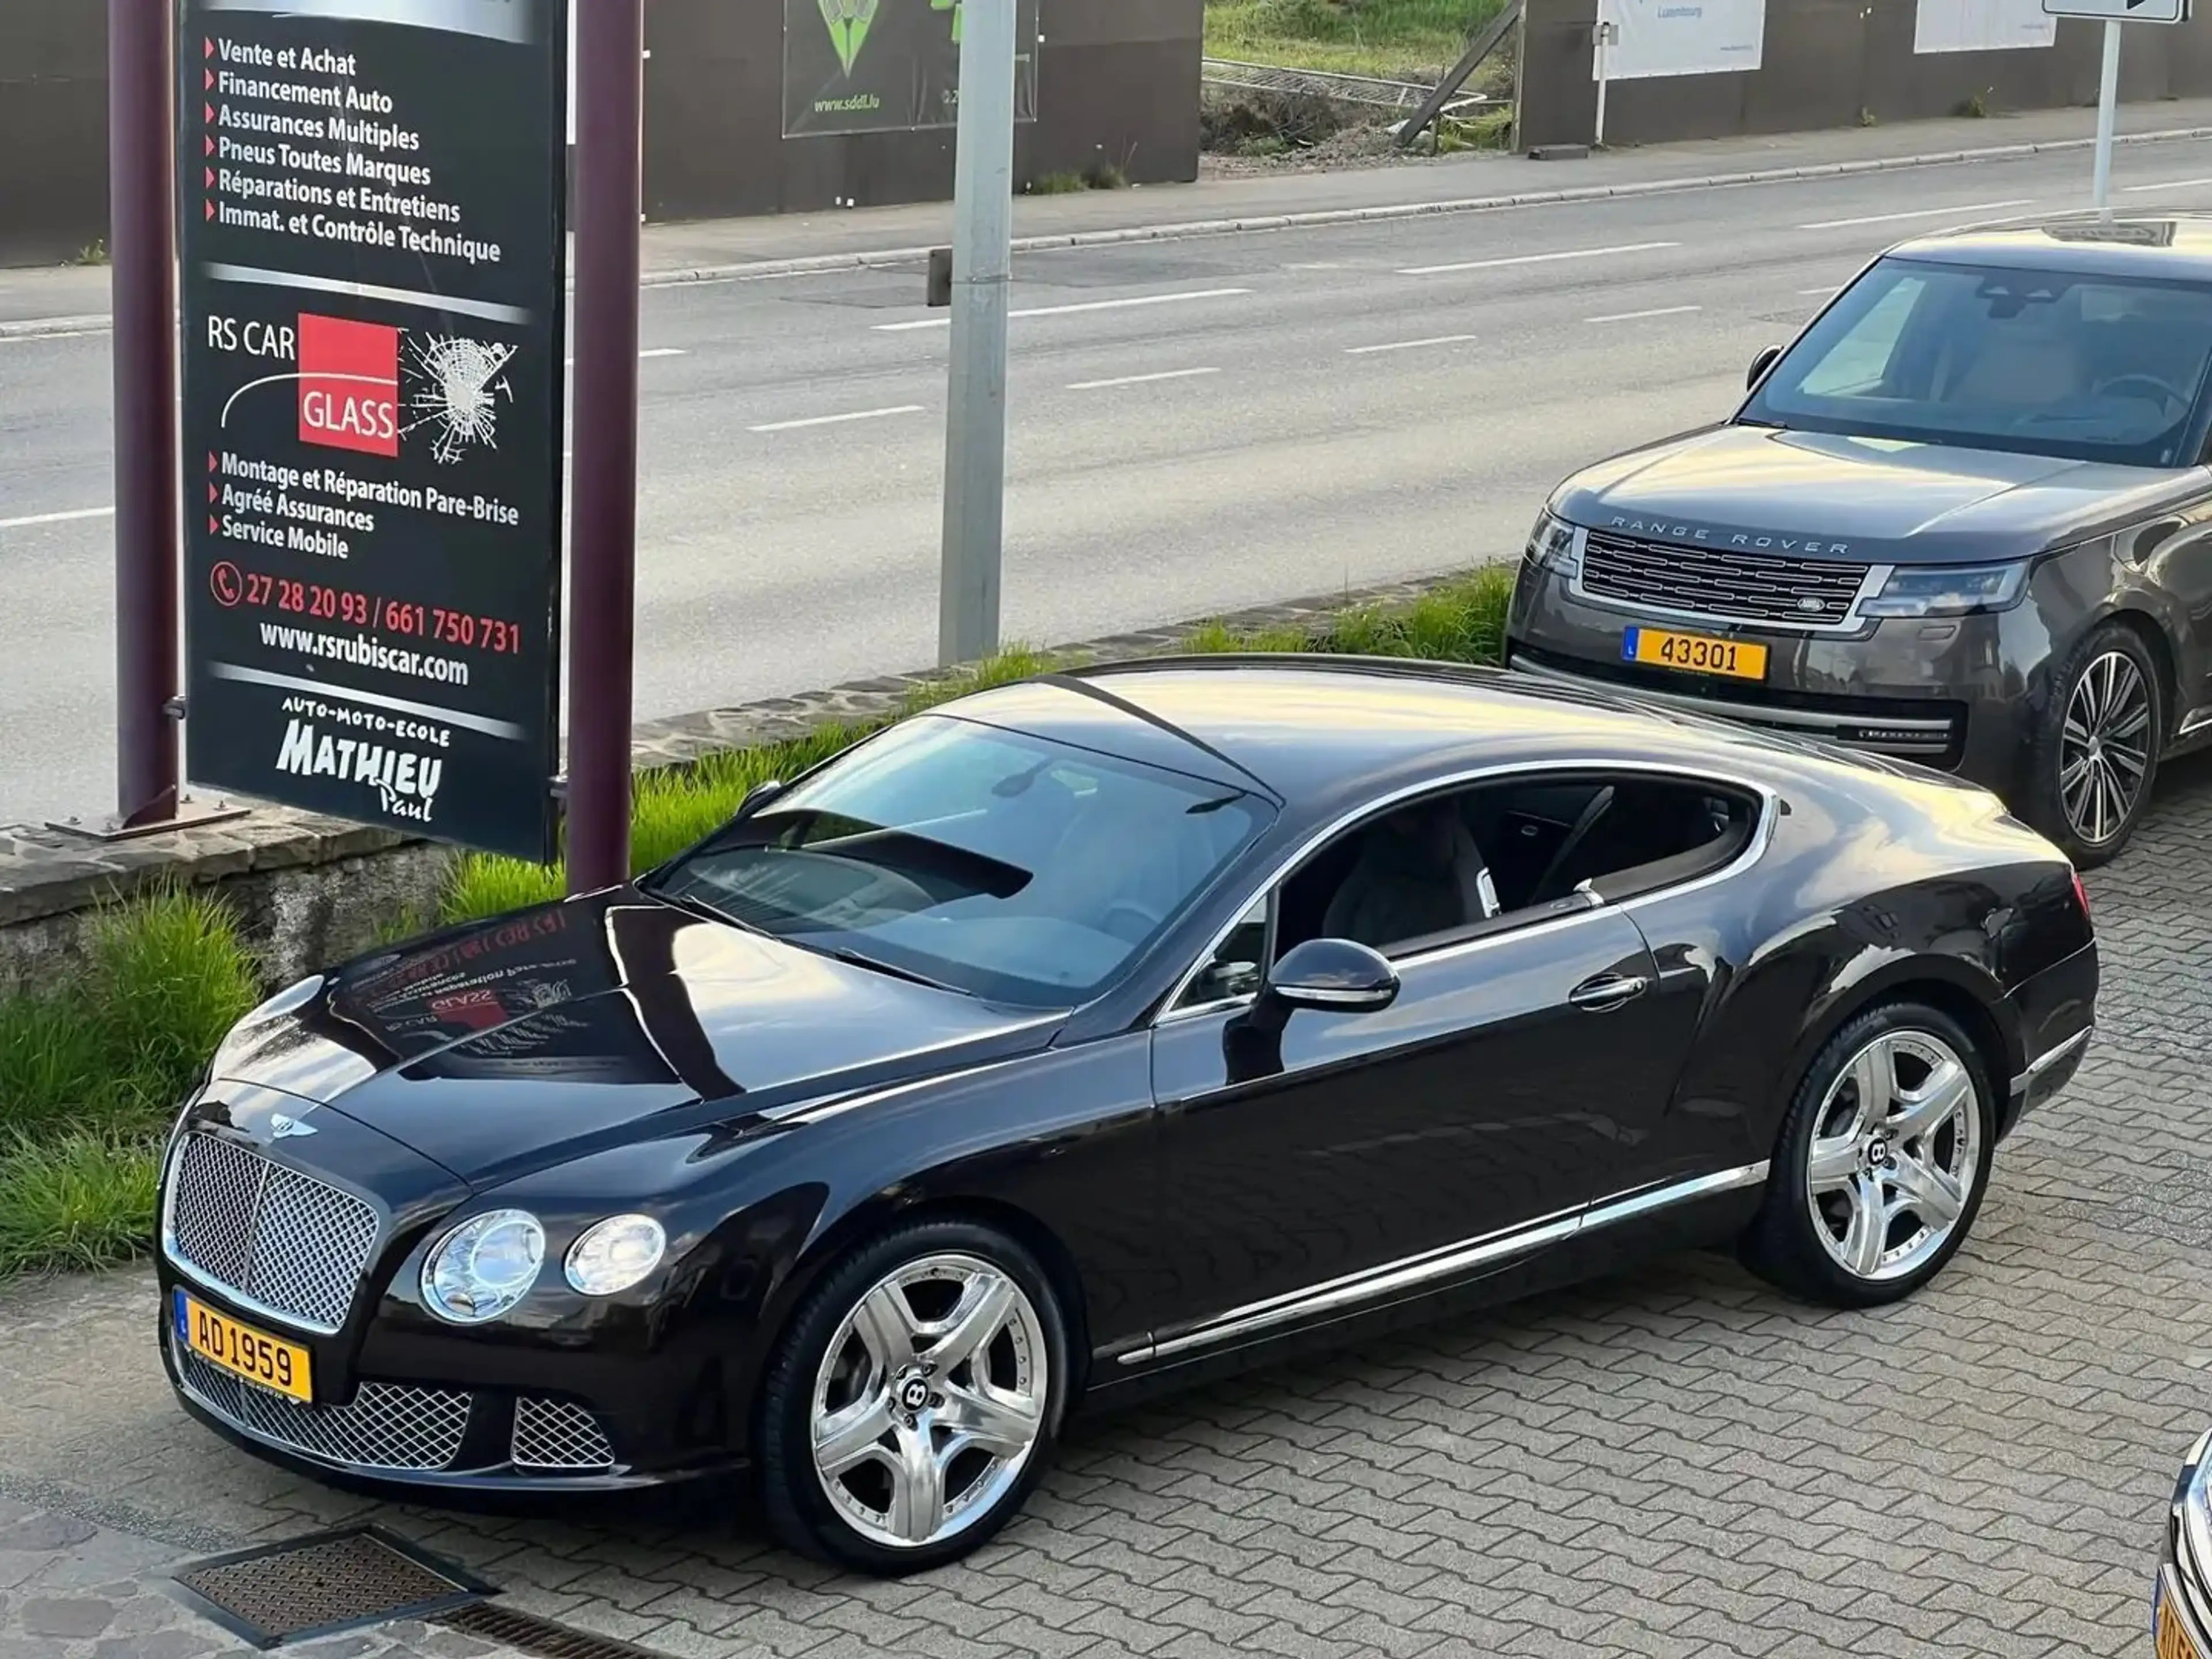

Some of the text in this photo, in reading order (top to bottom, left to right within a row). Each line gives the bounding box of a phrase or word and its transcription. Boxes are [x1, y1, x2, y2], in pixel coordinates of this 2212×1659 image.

[219, 38, 355, 76] Vente et Achat
[219, 72, 392, 113] Financement Auto
[219, 105, 419, 151] Assurances Multiples
[219, 137, 430, 186] Pneus Toutes Marques
[219, 169, 460, 223] Réparations et Entretiens
[219, 202, 501, 264] Immat. et Contrôle Technique
[209, 316, 295, 361] RS CAR
[304, 391, 393, 438] GLASS
[222, 451, 518, 525] Montage et Réparation Pare-Brise
[222, 483, 374, 532] Agréé Assurances
[222, 516, 347, 559] Service Mobile
[1612, 516, 1848, 554] RANGE ROVER
[247, 574, 271, 605] 27
[279, 579, 302, 612] 28
[310, 586, 335, 617] 20
[342, 592, 366, 624] 93
[386, 601, 423, 635] 661
[434, 609, 473, 646] 750
[480, 618, 518, 654] 731
[260, 622, 468, 686] www.rsrubiscar.com
[1661, 637, 1736, 671] 43301
[282, 696, 450, 748] AUTO-MOTO-ECOLE
[374, 779, 433, 823] Paul
[199, 1310, 224, 1357] AD
[230, 1327, 291, 1387] 1959
